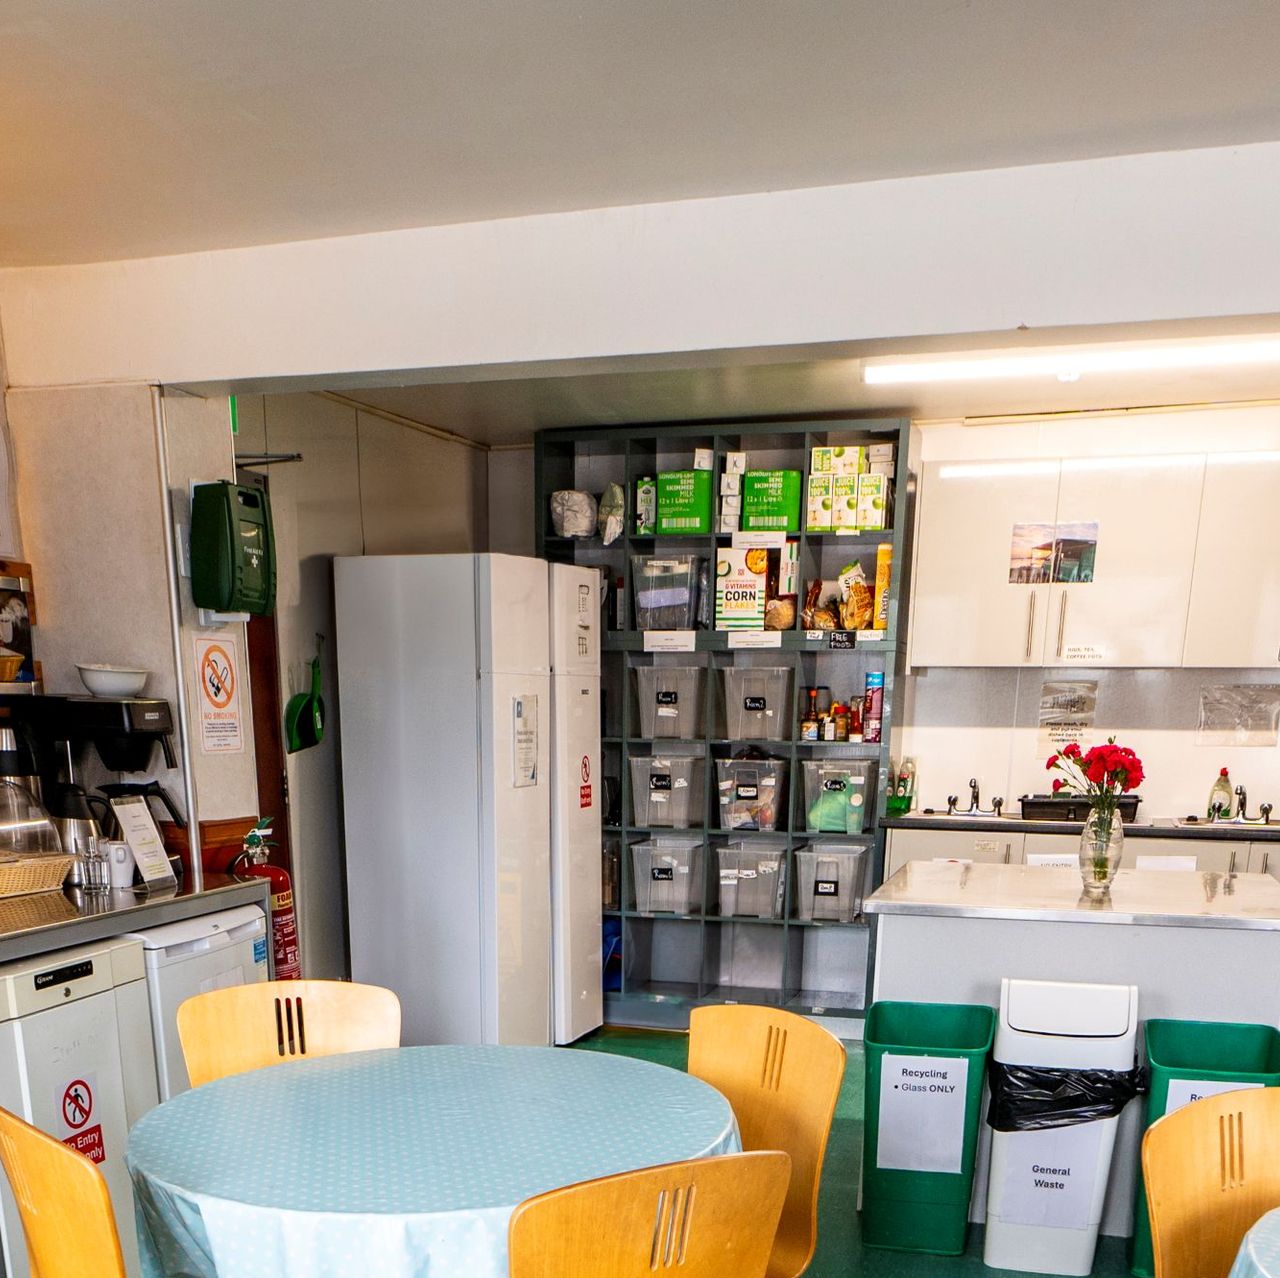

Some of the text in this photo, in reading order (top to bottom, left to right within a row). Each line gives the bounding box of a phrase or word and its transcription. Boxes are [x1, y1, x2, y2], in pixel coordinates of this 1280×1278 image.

[725, 591, 756, 601] CORN
[831, 632, 848, 641] FREE
[902, 1068, 948, 1080] Recycling
[901, 1083, 955, 1093] Glass ONLY
[77, 1131, 99, 1149] Entry
[1032, 1164, 1071, 1176] General
[1034, 1179, 1065, 1190] Waste
